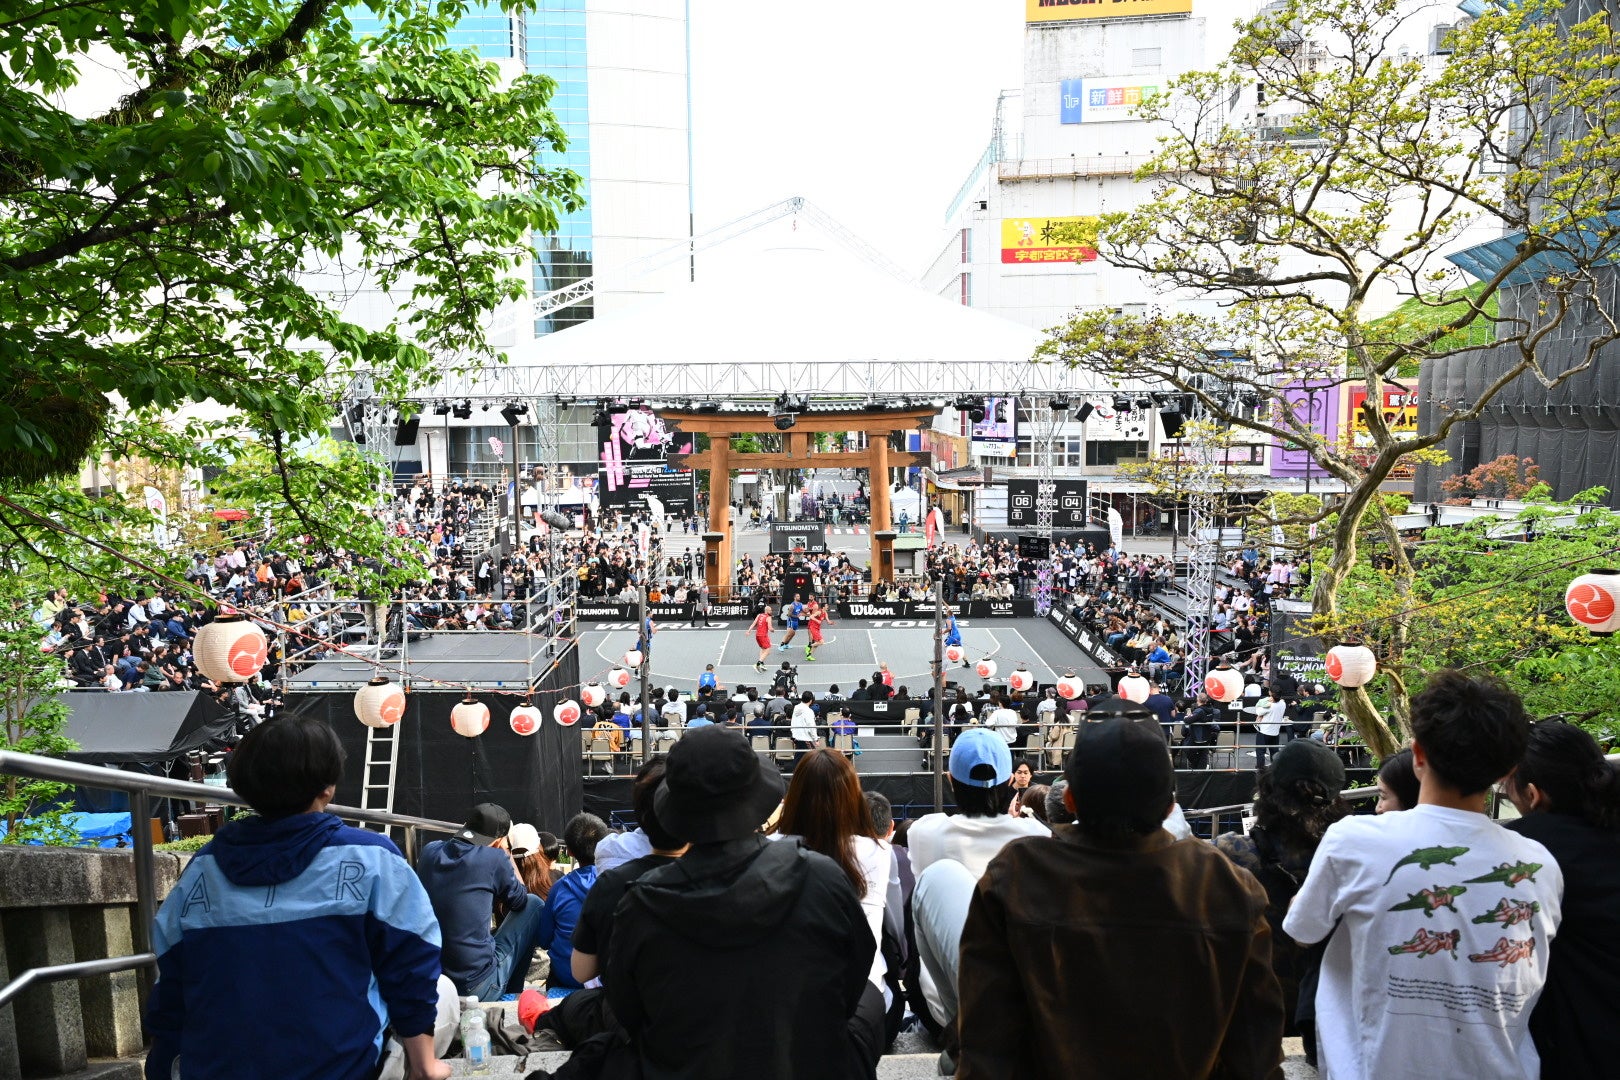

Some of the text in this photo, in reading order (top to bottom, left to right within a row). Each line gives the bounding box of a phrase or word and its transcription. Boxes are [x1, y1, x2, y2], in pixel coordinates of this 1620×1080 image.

[1064, 95, 1079, 108] 1F
[1015, 249, 1082, 261] 宇都宮餃子
[1015, 497, 1029, 506] 06
[1065, 498, 1079, 507] 04
[713, 605, 749, 616] 足利銀行
[850, 603, 896, 616] Wilson
